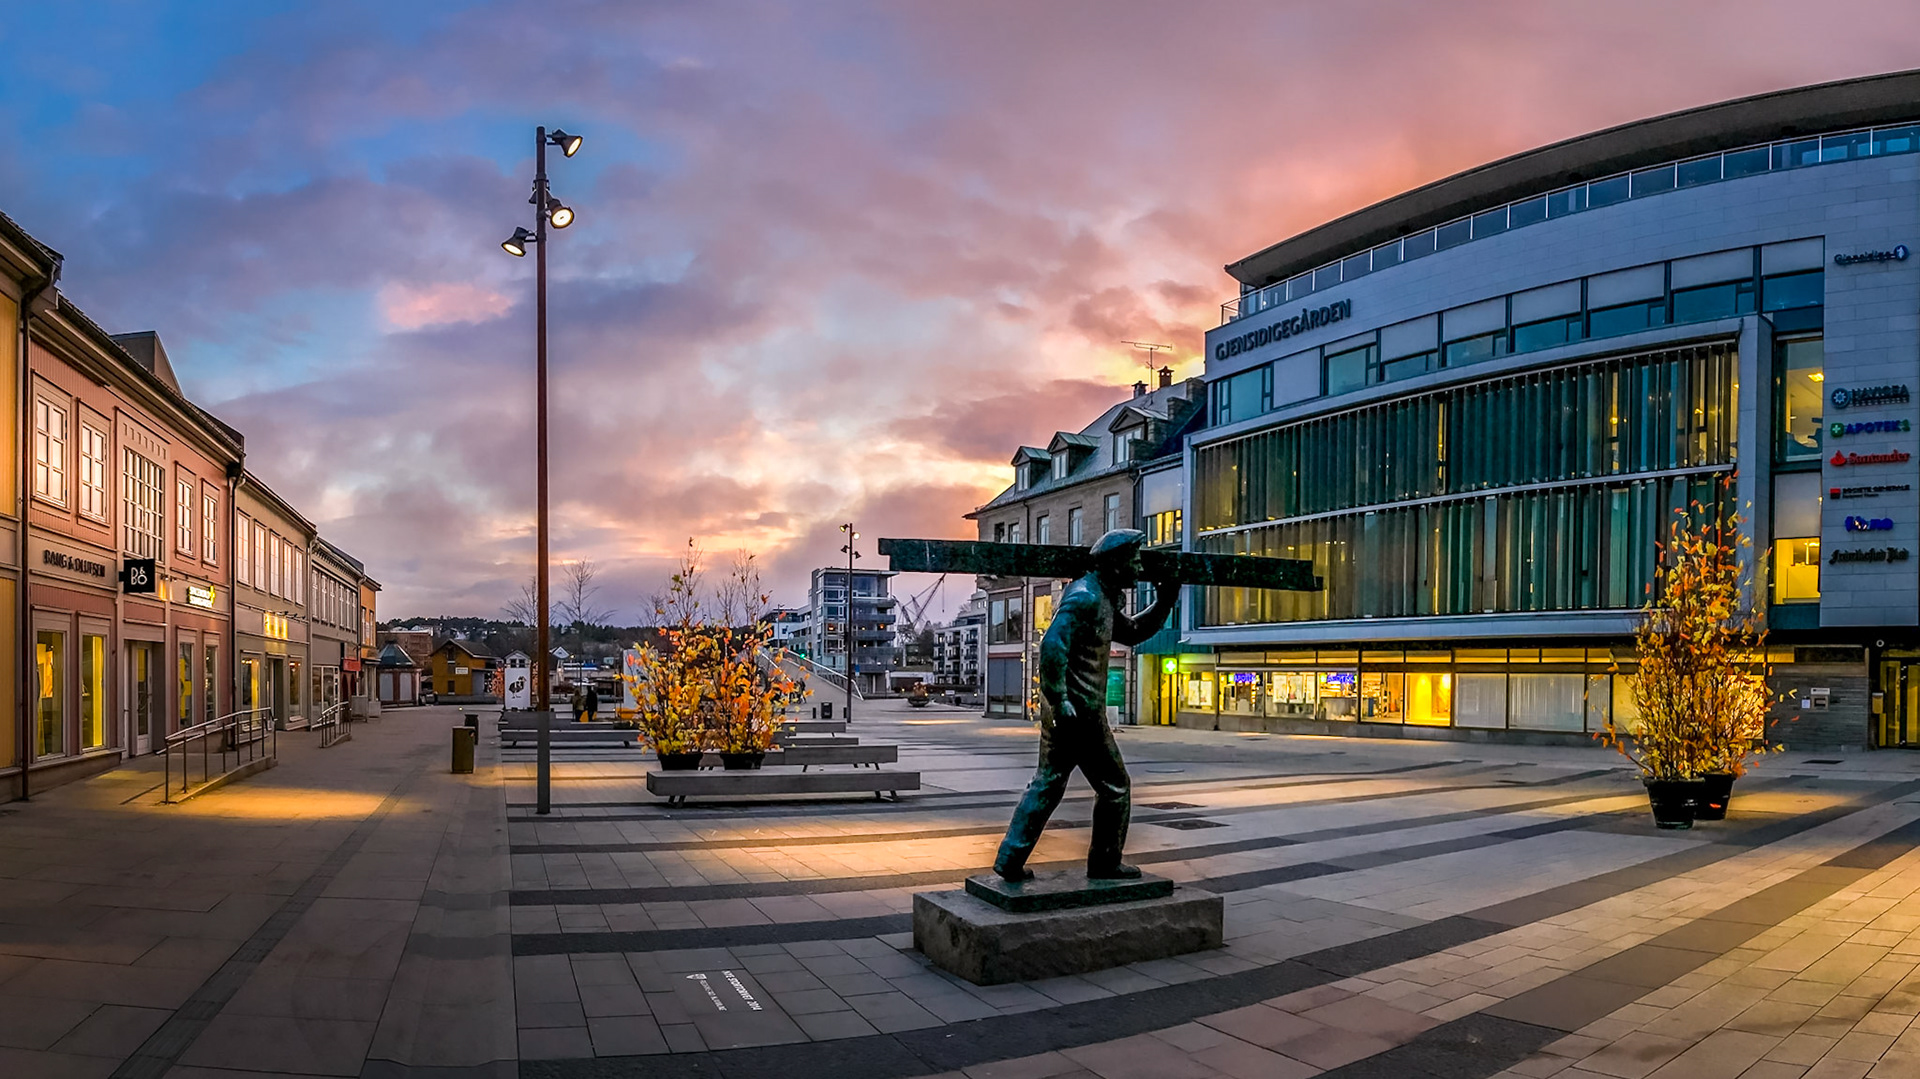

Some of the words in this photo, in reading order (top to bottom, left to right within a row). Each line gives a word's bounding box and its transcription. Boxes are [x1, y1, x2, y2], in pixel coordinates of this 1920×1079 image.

[1215, 298, 1352, 361] GJENSIDIGEGÅRDEN
[1845, 420, 1901, 434] APOTEK
[1848, 449, 1910, 465] Santander
[43, 549, 67, 569] BANG
[74, 557, 105, 578] OLUFSEN
